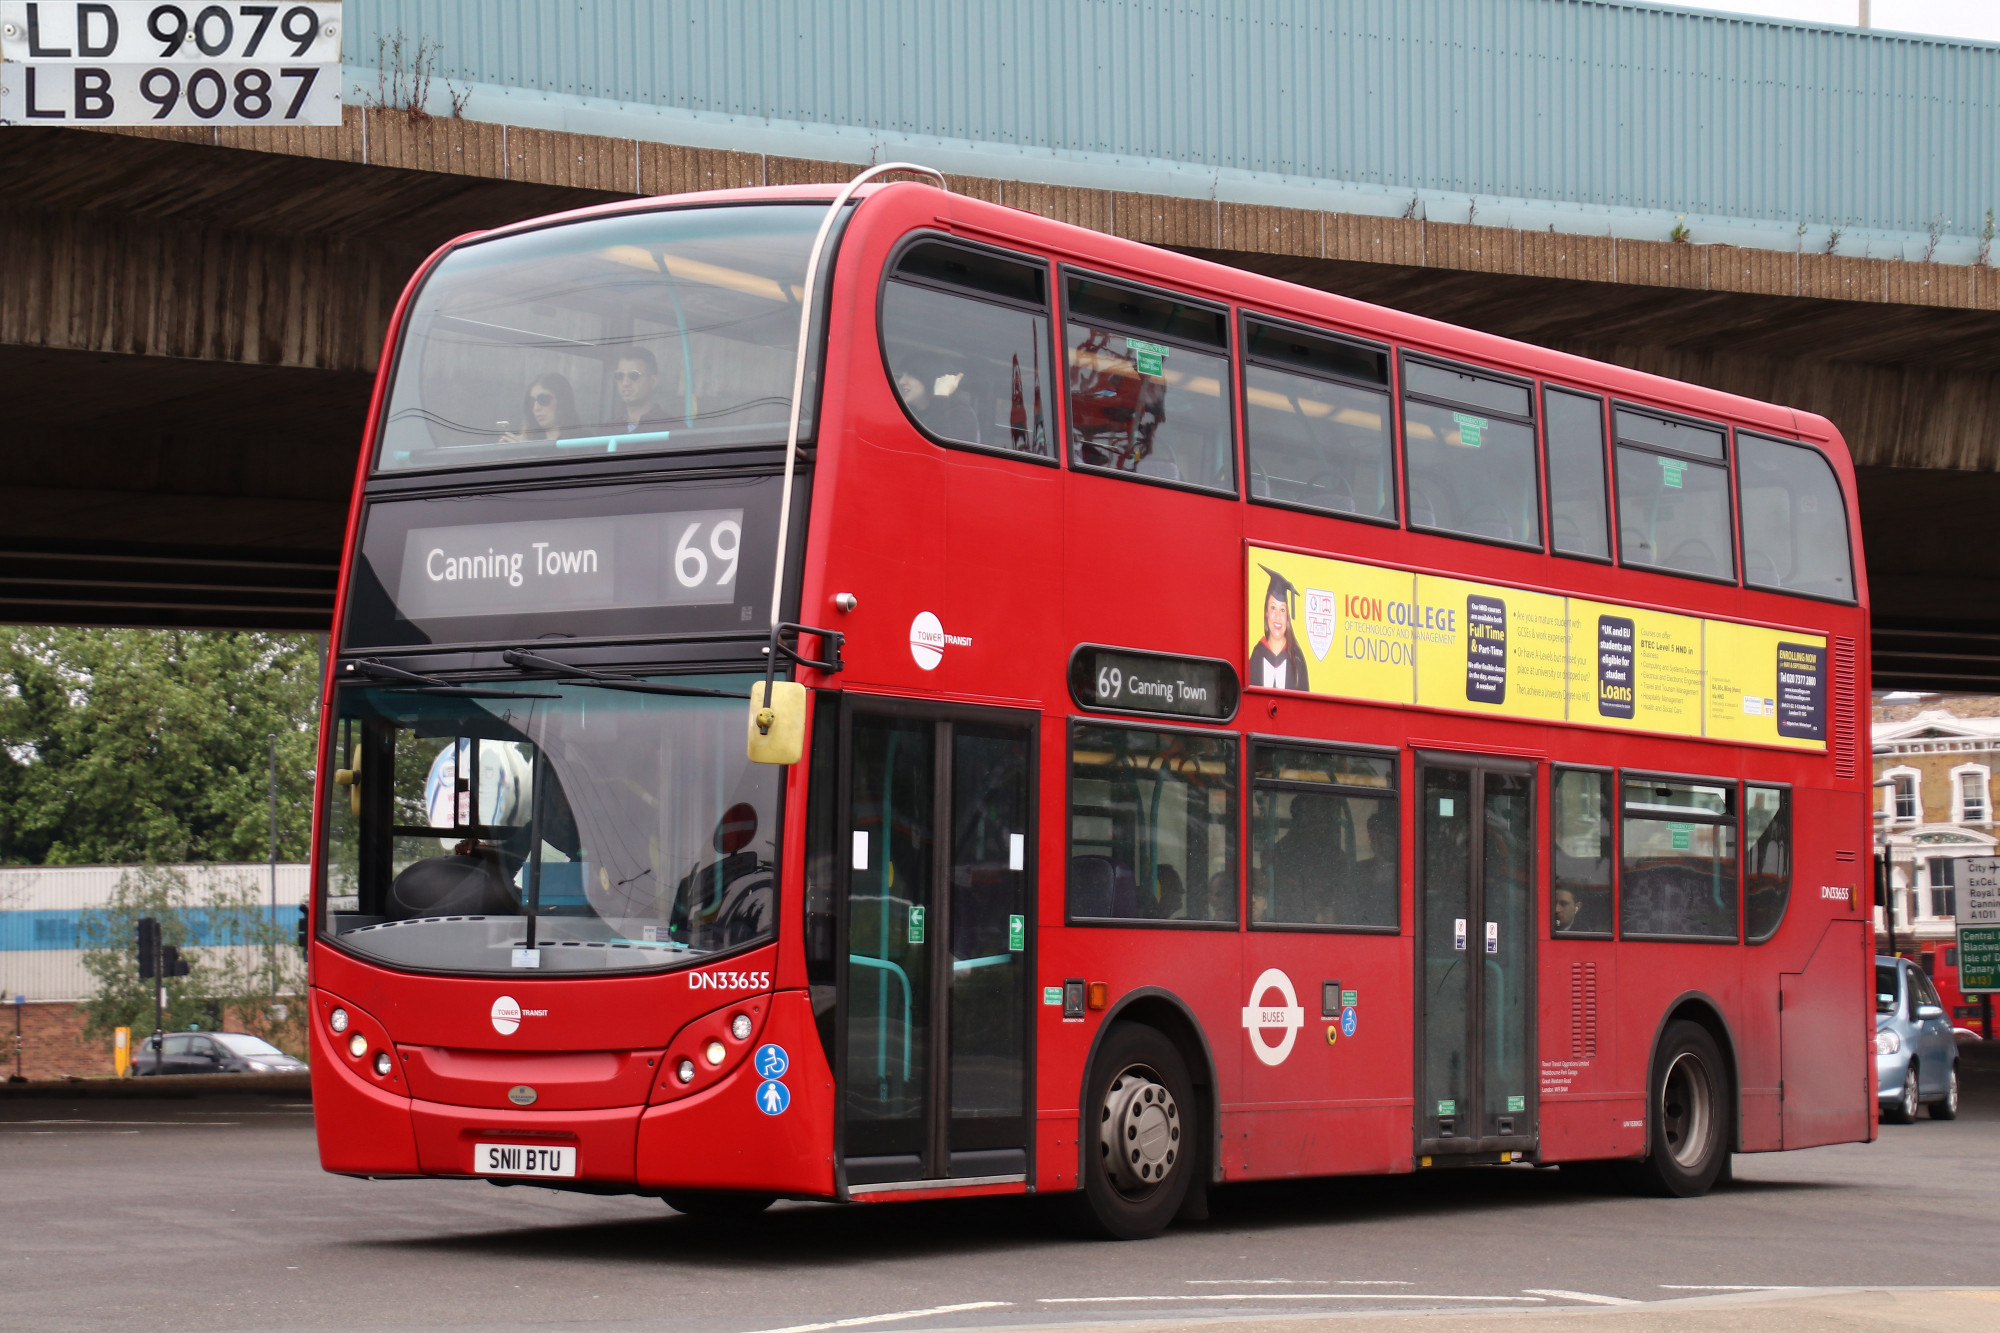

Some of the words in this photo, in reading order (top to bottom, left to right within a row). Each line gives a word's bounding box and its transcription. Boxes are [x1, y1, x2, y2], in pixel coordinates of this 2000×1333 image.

[674, 520, 741, 587] 69
[426, 548, 523, 587] Canning
[532, 543, 598, 575] Town
[1345, 594, 1382, 622] ICON
[1387, 601, 1456, 632] COLLEGE
[1539, 616, 1553, 626] mature
[1572, 618, 1581, 628] with
[1345, 620, 1353, 631] OF
[1355, 621, 1396, 637] TECHNOLOGY
[1397, 629, 1410, 639] AND
[1411, 630, 1456, 645] MANAGEMENT
[1470, 623, 1484, 637] Full
[1486, 625, 1504, 640] Time
[1518, 626, 1531, 638] GCSEs
[1537, 630, 1546, 640] work
[1613, 627, 1622, 637] and
[1624, 628, 1630, 638] EU
[1641, 628, 1656, 637] Courses
[918, 631, 942, 642] TOWER
[944, 634, 972, 646] TRANSIT
[1345, 634, 1414, 666] LONDON
[1471, 639, 1477, 652] &
[1478, 644, 1503, 656] Part-Time
[1600, 640, 1622, 650] students
[1623, 644, 1631, 652] are
[1641, 640, 1654, 649] BTEC
[1676, 645, 1687, 654] HND
[1518, 647, 1523, 657] Or
[1524, 648, 1534, 659] have
[1577, 658, 1586, 666] your
[1602, 654, 1621, 666] eligible
[1643, 650, 1658, 659] Business
[1780, 650, 1805, 662] ENROLLING
[1806, 653, 1816, 664] NOW
[1643, 661, 1661, 671] Computing
[1517, 664, 1529, 675] place
[1530, 666, 1535, 675] at
[1536, 667, 1556, 680] university
[1581, 672, 1590, 682] out?
[1606, 670, 1626, 680] student
[1643, 671, 1658, 680] Electrical
[1667, 675, 1683, 683] Electronic
[1099, 666, 1122, 698] 69
[1129, 676, 1173, 702] Canning
[1176, 680, 1206, 700] Town
[1796, 675, 1806, 685] 7377
[1527, 686, 1541, 696] achieve
[1582, 693, 1590, 702] HND
[1601, 680, 1631, 701] Loans
[1662, 684, 1675, 692] Tourism
[1676, 687, 1699, 696] Management
[1643, 693, 1660, 702] Hospitality
[1662, 695, 1683, 704] Management
[1969, 864, 1986, 873] City
[1970, 878, 1997, 886] ExCeL
[1822, 886, 1849, 900] DN33655
[1970, 889, 1994, 898] Royal
[1971, 910, 1996, 918] A1011
[1963, 932, 1995, 940] Central
[1983, 953, 1991, 961] of
[1965, 964, 1995, 974] Canary
[689, 972, 770, 989] DN33655
[1966, 975, 1992, 985] (A13)
[1262, 1011, 1285, 1022] BUSES
[490, 1148, 520, 1170] SN11
[526, 1150, 561, 1171] BTU
